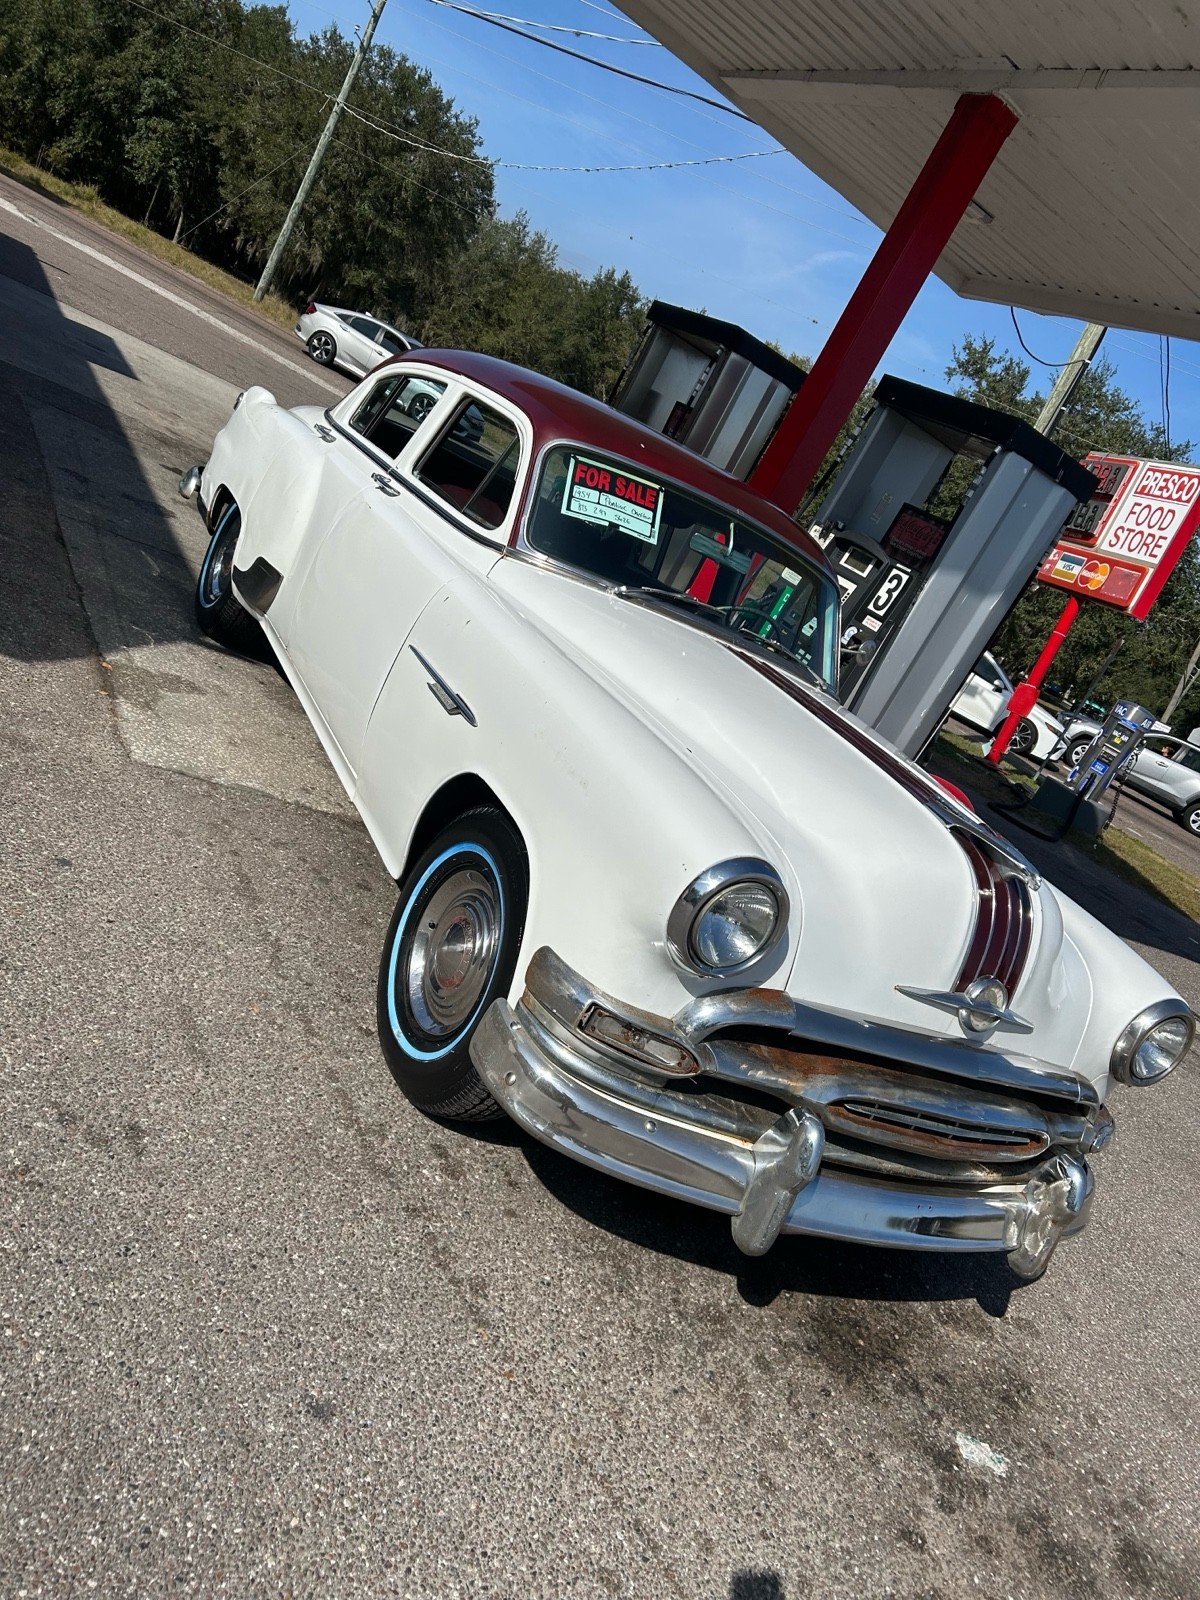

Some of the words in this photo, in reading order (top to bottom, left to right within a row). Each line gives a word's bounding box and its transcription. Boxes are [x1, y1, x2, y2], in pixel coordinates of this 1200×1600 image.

[574, 489, 591, 499] 1954
[575, 464, 610, 491] FOR
[615, 477, 657, 509] SALE
[1137, 470, 1199, 501] PRESCO
[1124, 502, 1176, 531] FOOD
[1108, 526, 1168, 559] STORE
[1062, 563, 1075, 572] VISA
[872, 573, 903, 611] 3
[1115, 704, 1127, 716] VAC
[1140, 718, 1152, 730] AIR
